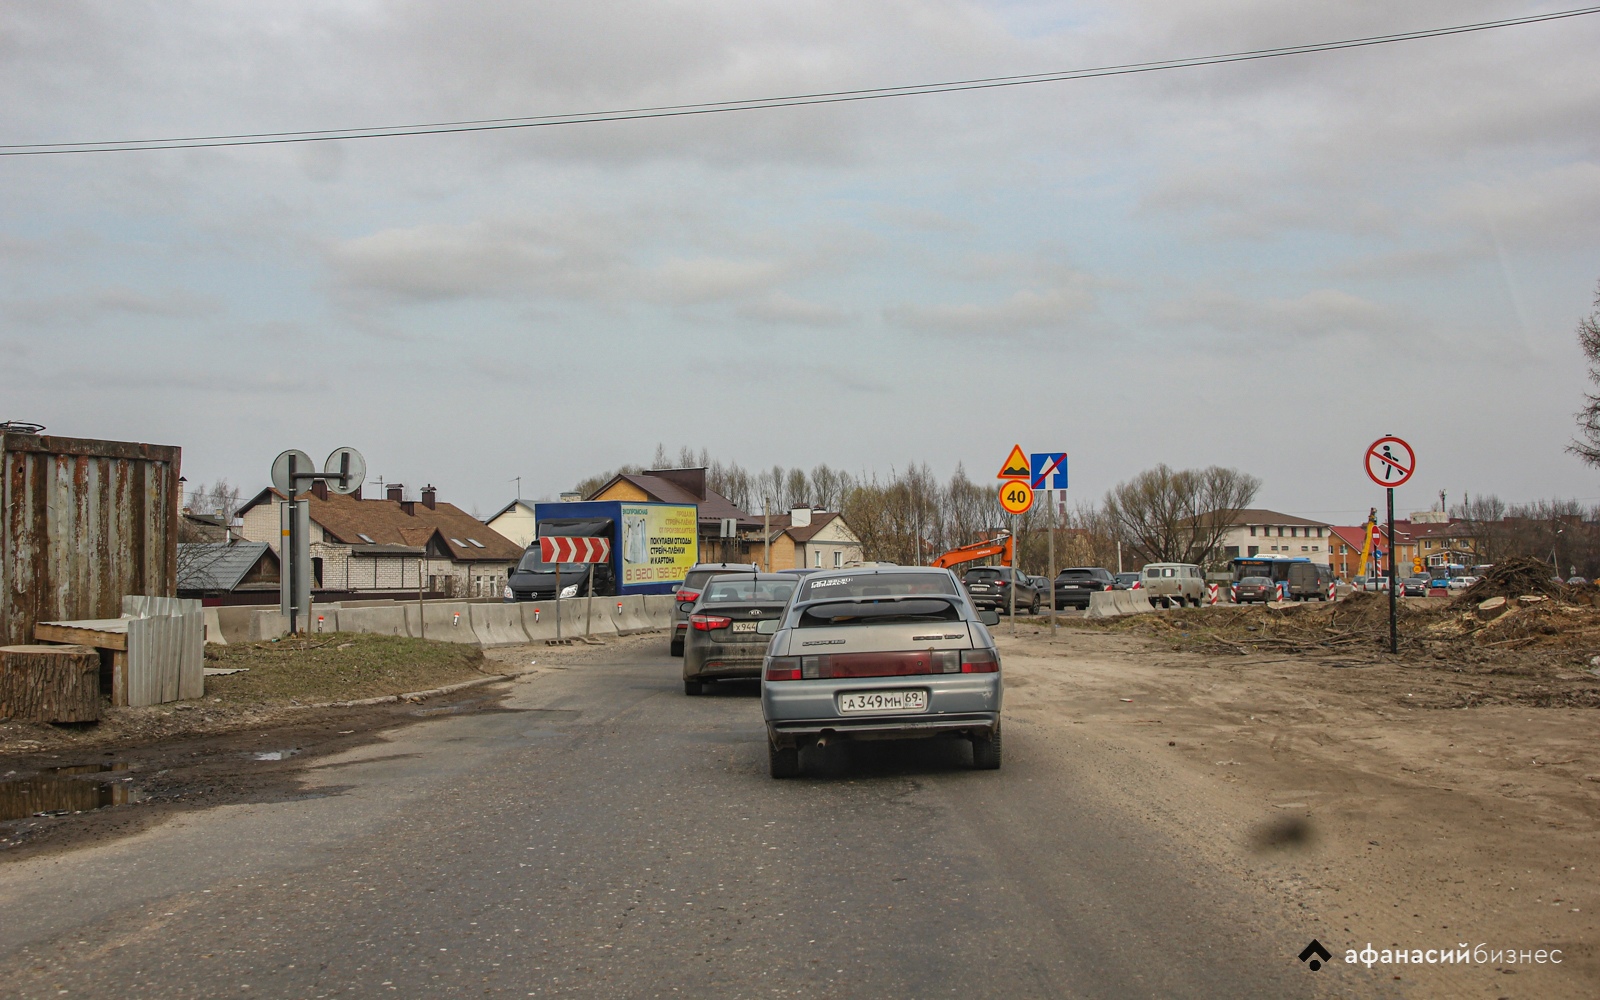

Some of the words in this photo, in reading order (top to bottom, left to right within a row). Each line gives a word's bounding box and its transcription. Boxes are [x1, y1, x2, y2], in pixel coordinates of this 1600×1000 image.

[1007, 490, 1026, 503] 40
[650, 537, 674, 545] ПОКУПАЕМ
[674, 537, 692, 545] ОТХОДЫ
[654, 556, 675, 564] КАРТОНА
[626, 569, 632, 581] 8
[656, 565, 691, 579] 158-97-6
[905, 692, 918, 703] 69
